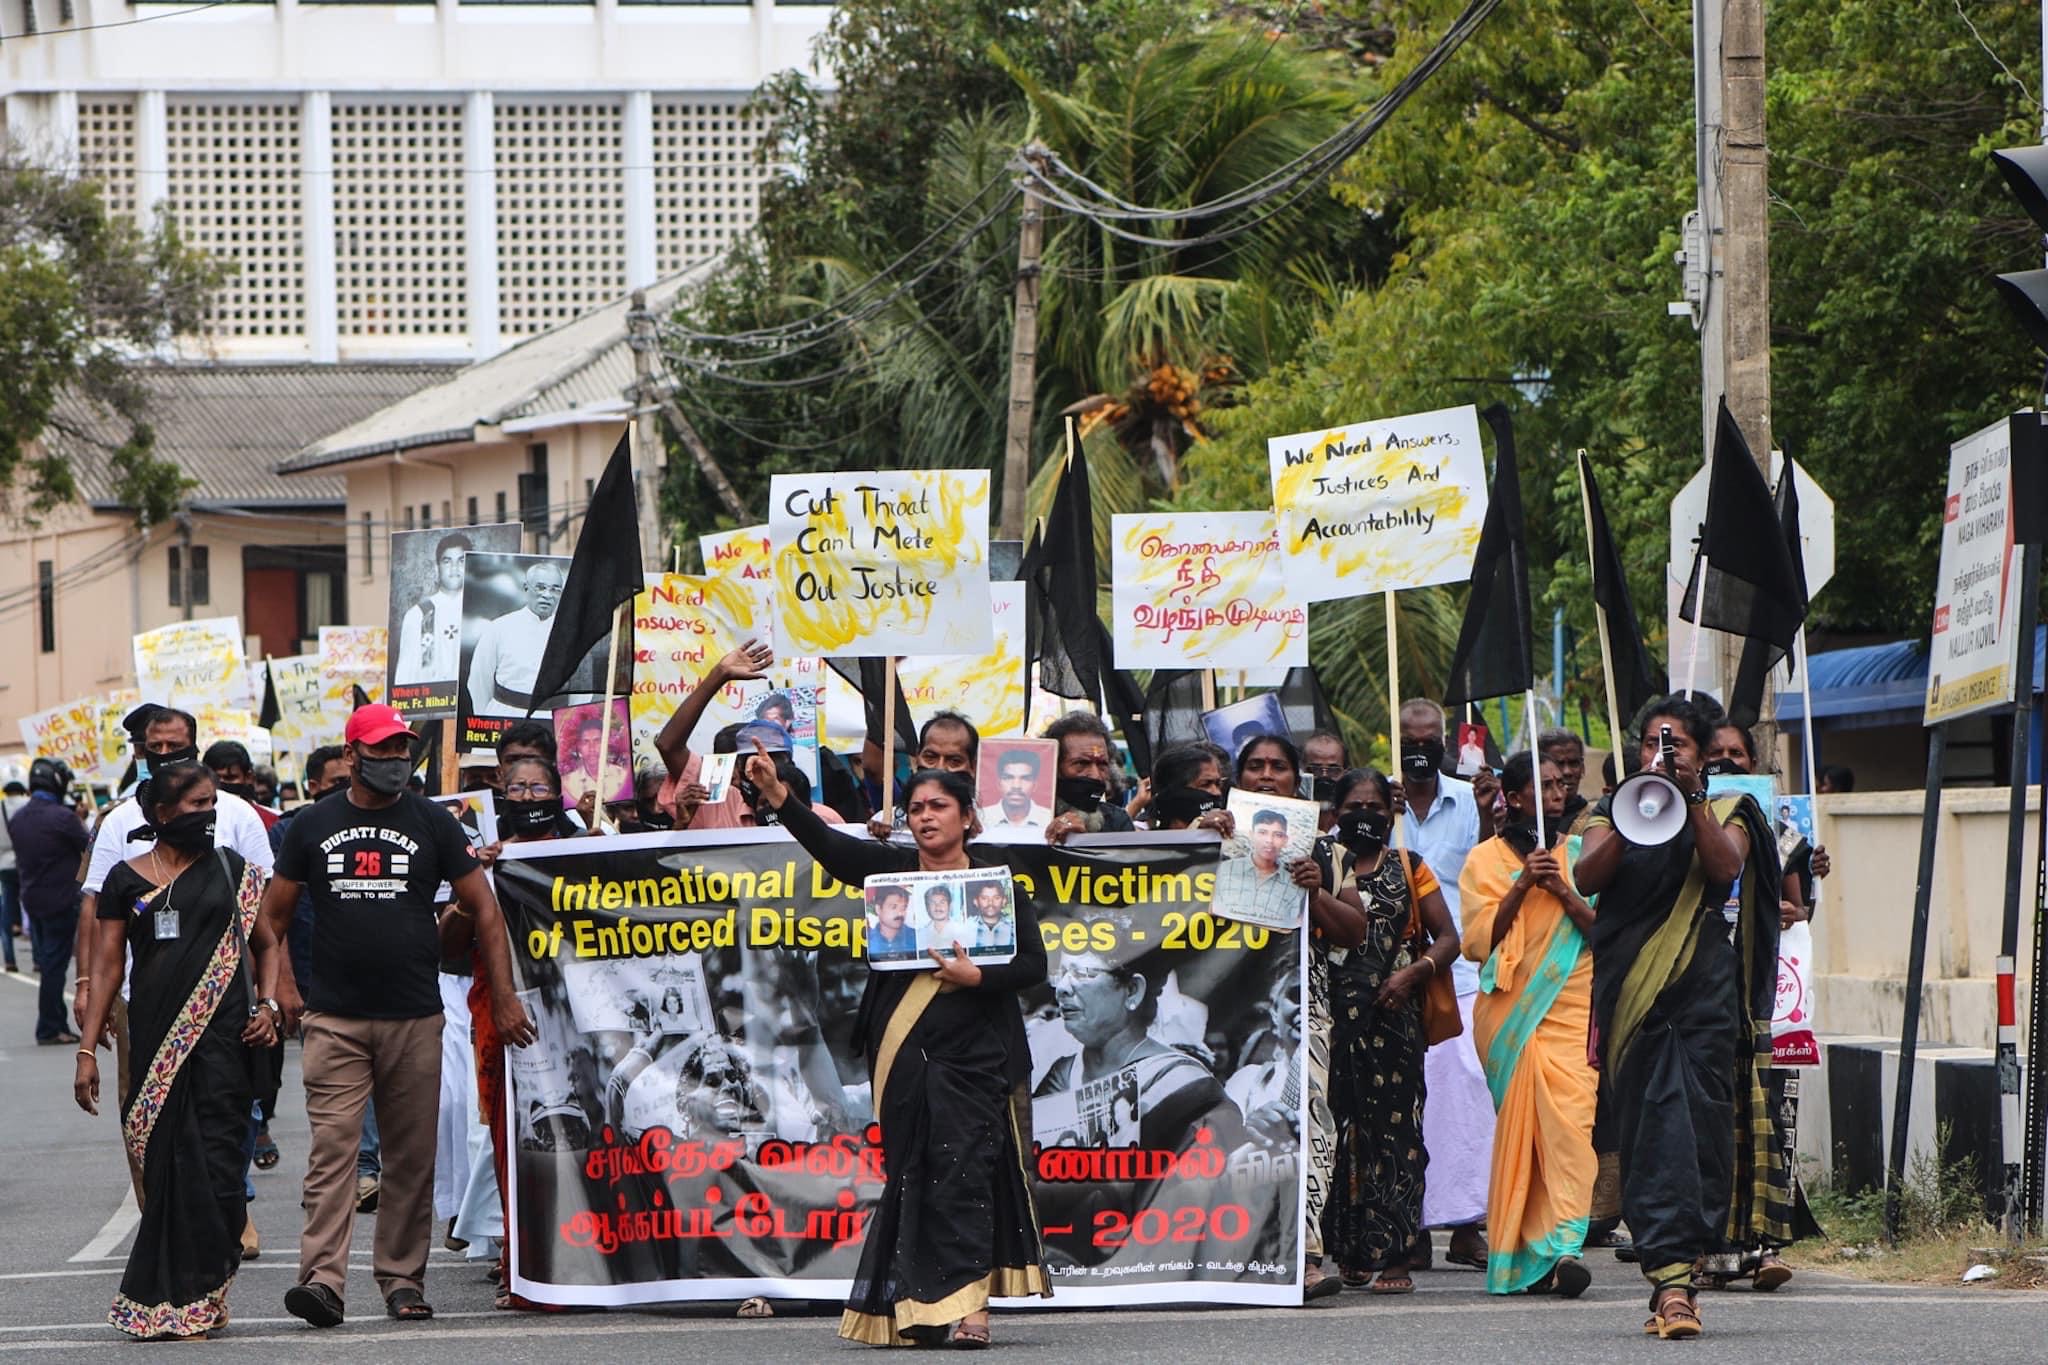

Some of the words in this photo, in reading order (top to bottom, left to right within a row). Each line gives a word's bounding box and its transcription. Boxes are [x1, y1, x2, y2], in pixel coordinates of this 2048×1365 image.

[1284, 450, 1314, 467] We
[1325, 437, 1372, 461] Need
[1312, 474, 1389, 496] Justices
[1407, 464, 1440, 484] And
[785, 487, 838, 517] Cut
[853, 485, 929, 518] Throat
[873, 525, 934, 550] Mete
[714, 542, 742, 562] We
[651, 585, 705, 606] Need
[850, 566, 938, 600] Justice
[633, 615, 717, 634] nswers,
[671, 644, 705, 663] and
[391, 699, 411, 709] Rev.
[412, 700, 424, 709] Fr.
[425, 696, 449, 708] Nihal
[392, 687, 420, 698] Where
[421, 686, 431, 697] is
[32, 713, 66, 738] WE
[467, 717, 500, 730] Where
[37, 731, 76, 757] NOT
[465, 730, 488, 743] Rev.
[320, 827, 377, 854] DUCATI
[379, 828, 419, 856] GEAR
[354, 851, 381, 876] 26
[342, 881, 364, 889] SUPER
[367, 881, 393, 889] POWER
[551, 861, 796, 912] International
[1048, 865, 1217, 905] Victims
[528, 921, 564, 960] of
[573, 909, 736, 958] Enforced
[1161, 911, 1269, 951] 2020
[586, 1124, 746, 1186] சர்வதேச
[560, 1185, 873, 1255] ஆக்கப்பட்டோர்
[1092, 1204, 1251, 1248] 2020
[1157, 1258, 1194, 1273] சங்கம்
[1206, 1259, 1245, 1273] வடக்கு
[1247, 1260, 1287, 1276] கிழக்கு
